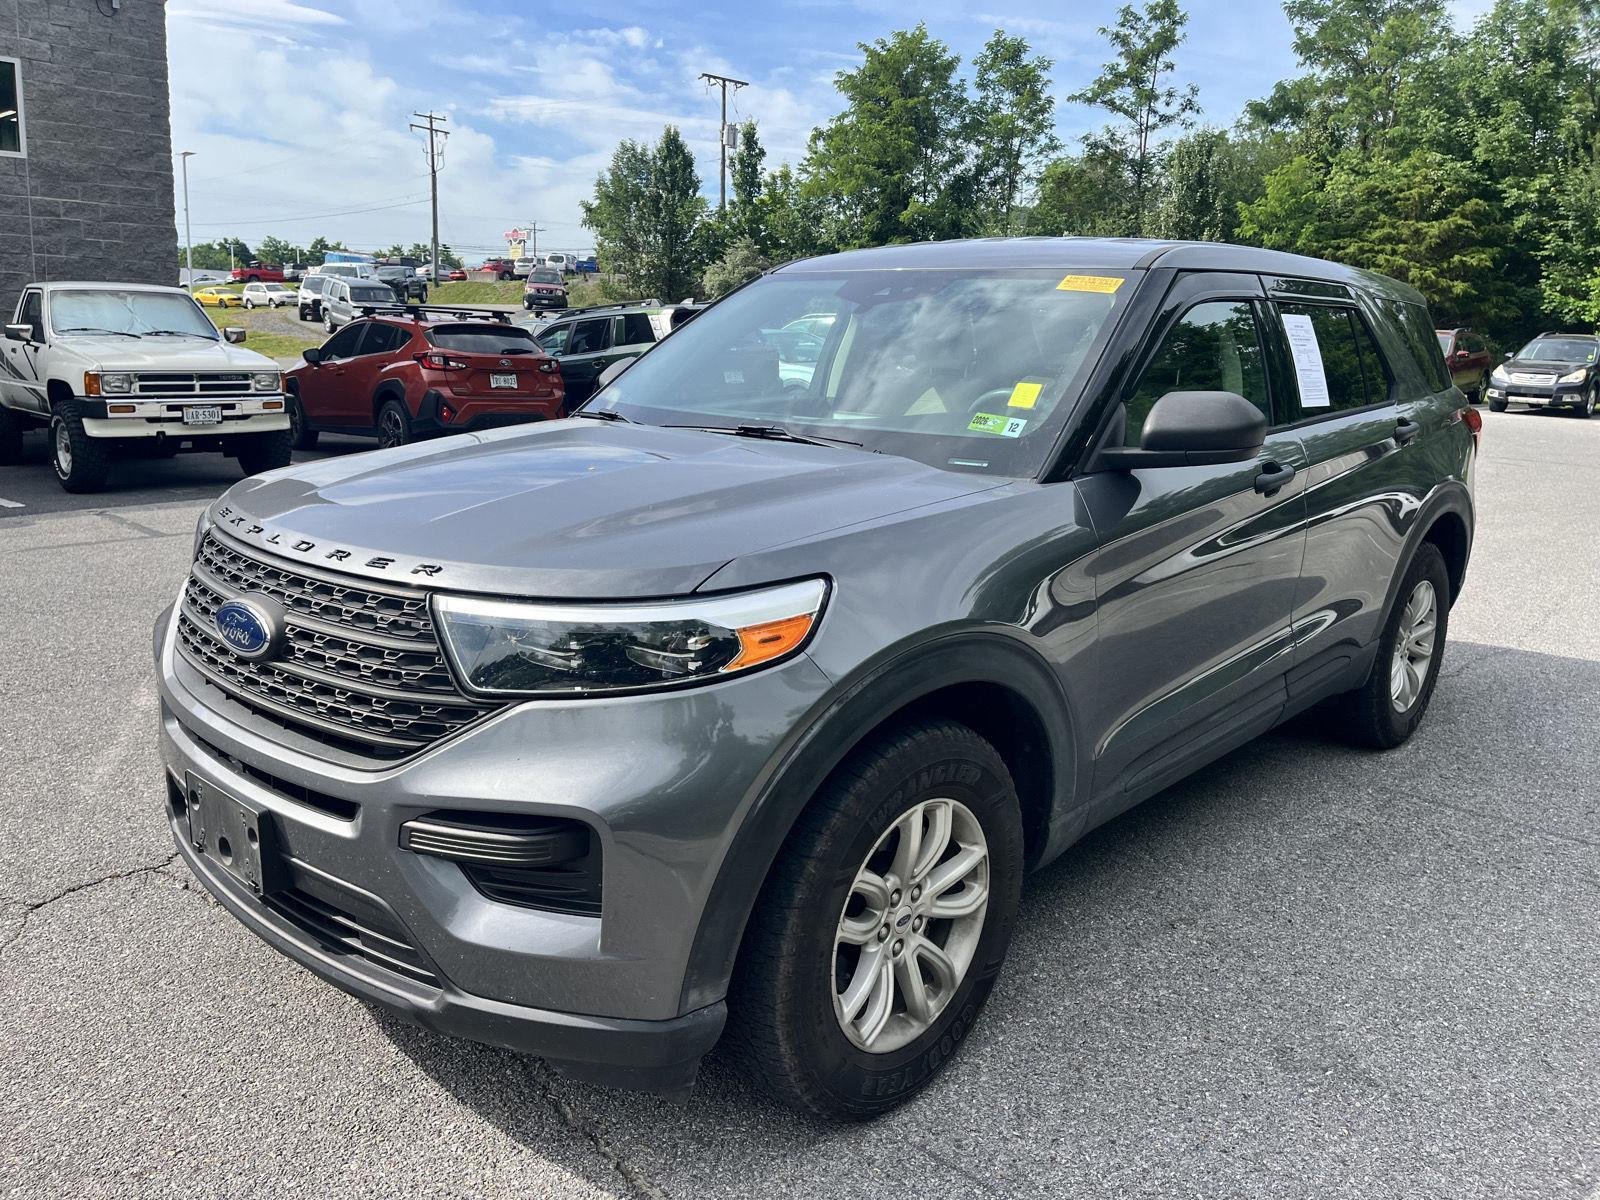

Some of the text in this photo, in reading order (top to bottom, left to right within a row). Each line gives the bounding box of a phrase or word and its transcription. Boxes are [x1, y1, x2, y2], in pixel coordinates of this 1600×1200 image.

[1008, 422, 1020, 433] 12
[218, 506, 444, 577] EXPLORER
[221, 611, 254, 645] Ford
